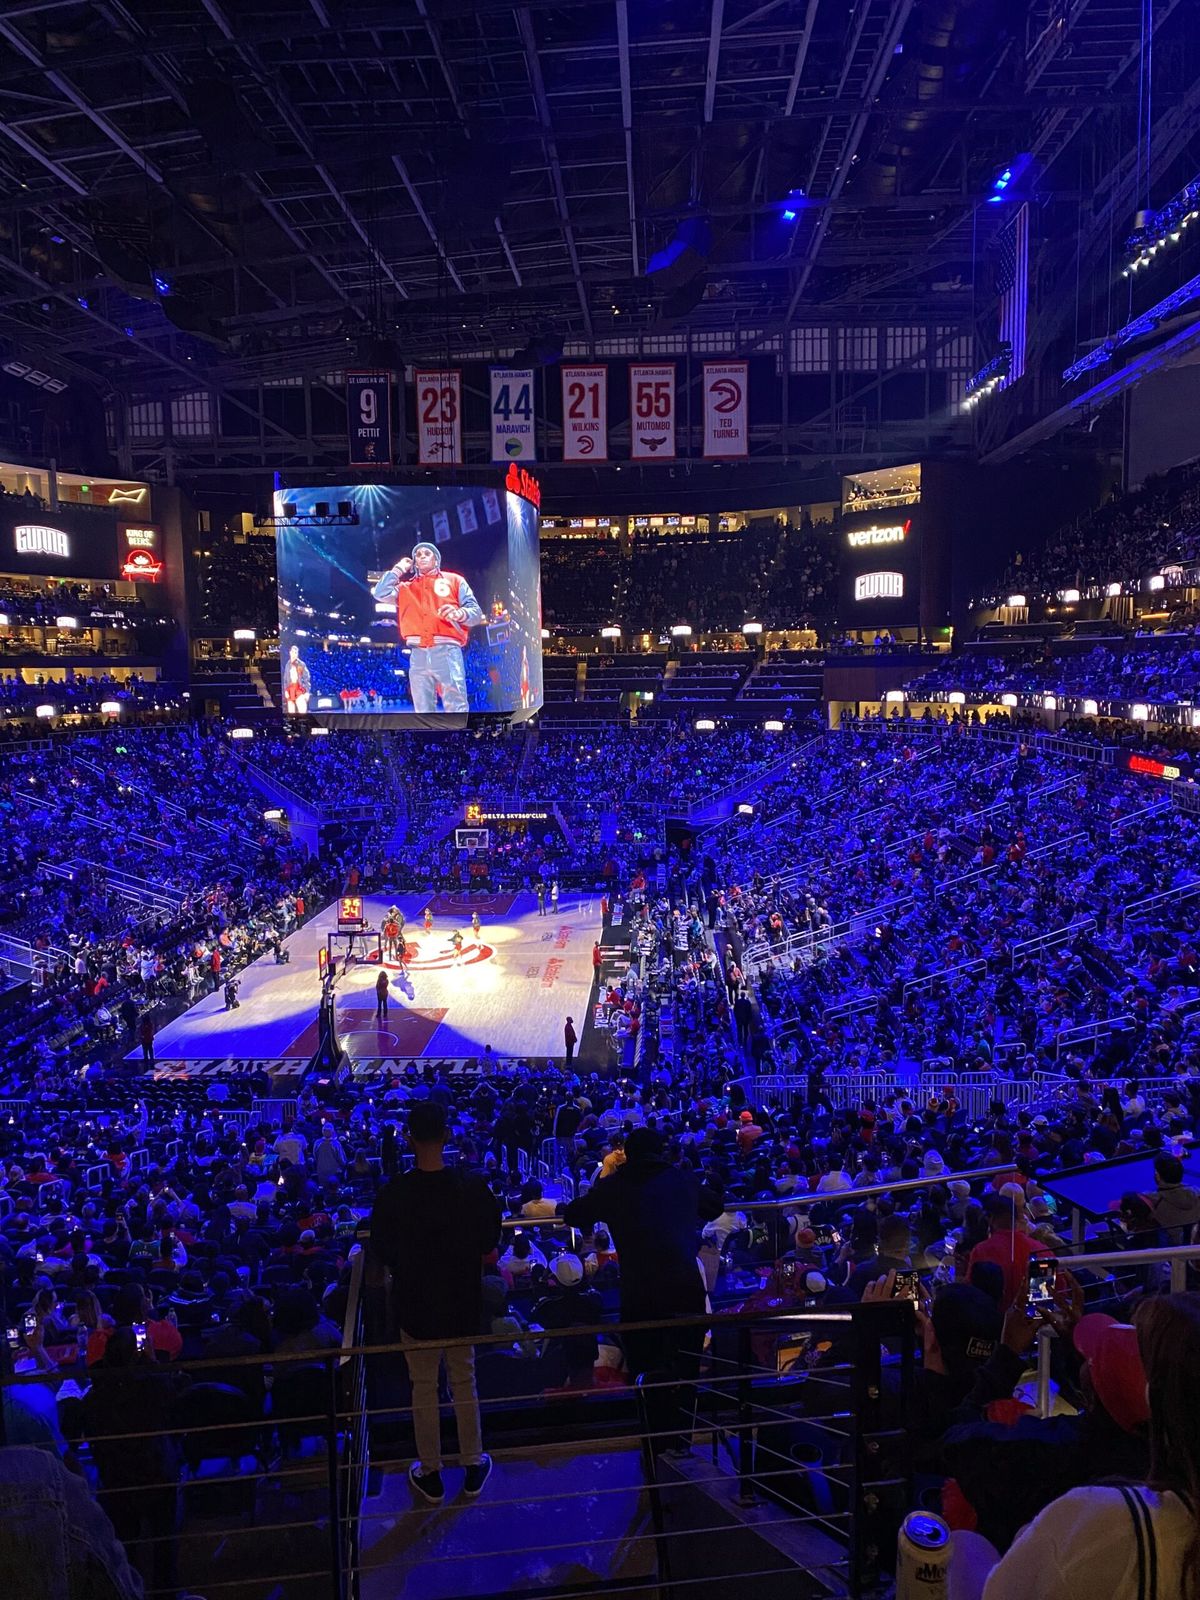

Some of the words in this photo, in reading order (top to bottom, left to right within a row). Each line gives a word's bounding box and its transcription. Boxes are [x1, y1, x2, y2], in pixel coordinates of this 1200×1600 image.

[360, 388, 377, 424] 9
[422, 387, 457, 423] 23
[493, 383, 533, 421] 44
[568, 382, 600, 419] 21
[636, 382, 671, 418] 55
[496, 424, 530, 434] MARAVICH
[571, 422, 600, 432] WILKINS
[636, 421, 670, 431] MUTOMBO
[719, 418, 732, 428] TED
[357, 427, 380, 438] PETTIT
[713, 429, 739, 439] TURNER
[847, 525, 905, 547] verizon
[342, 906, 359, 918] 24
